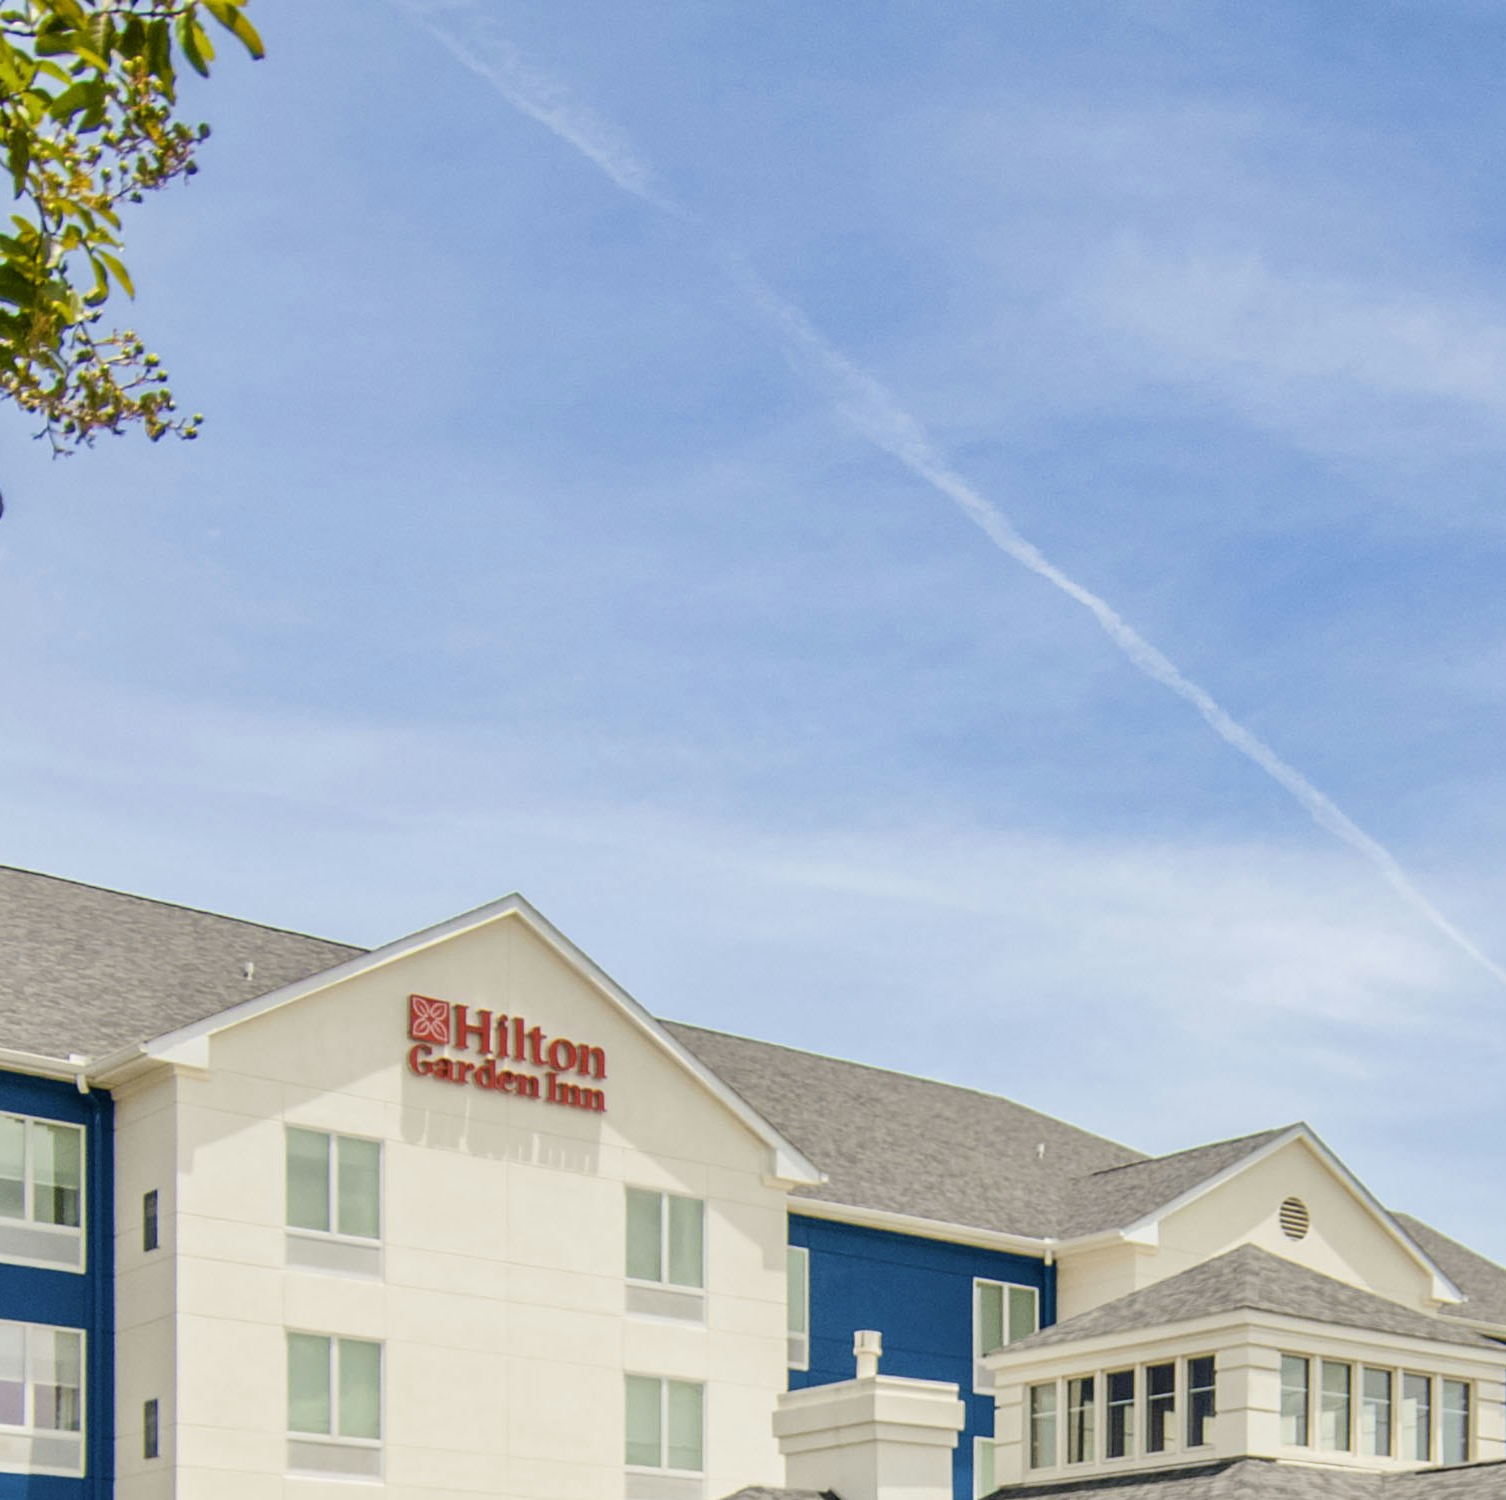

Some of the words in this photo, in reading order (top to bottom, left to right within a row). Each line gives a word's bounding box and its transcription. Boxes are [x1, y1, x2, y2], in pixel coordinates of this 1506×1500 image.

[453, 1003, 607, 1079] Hilton
[408, 1043, 541, 1099] Garden
[545, 1071, 607, 1112] Inn
